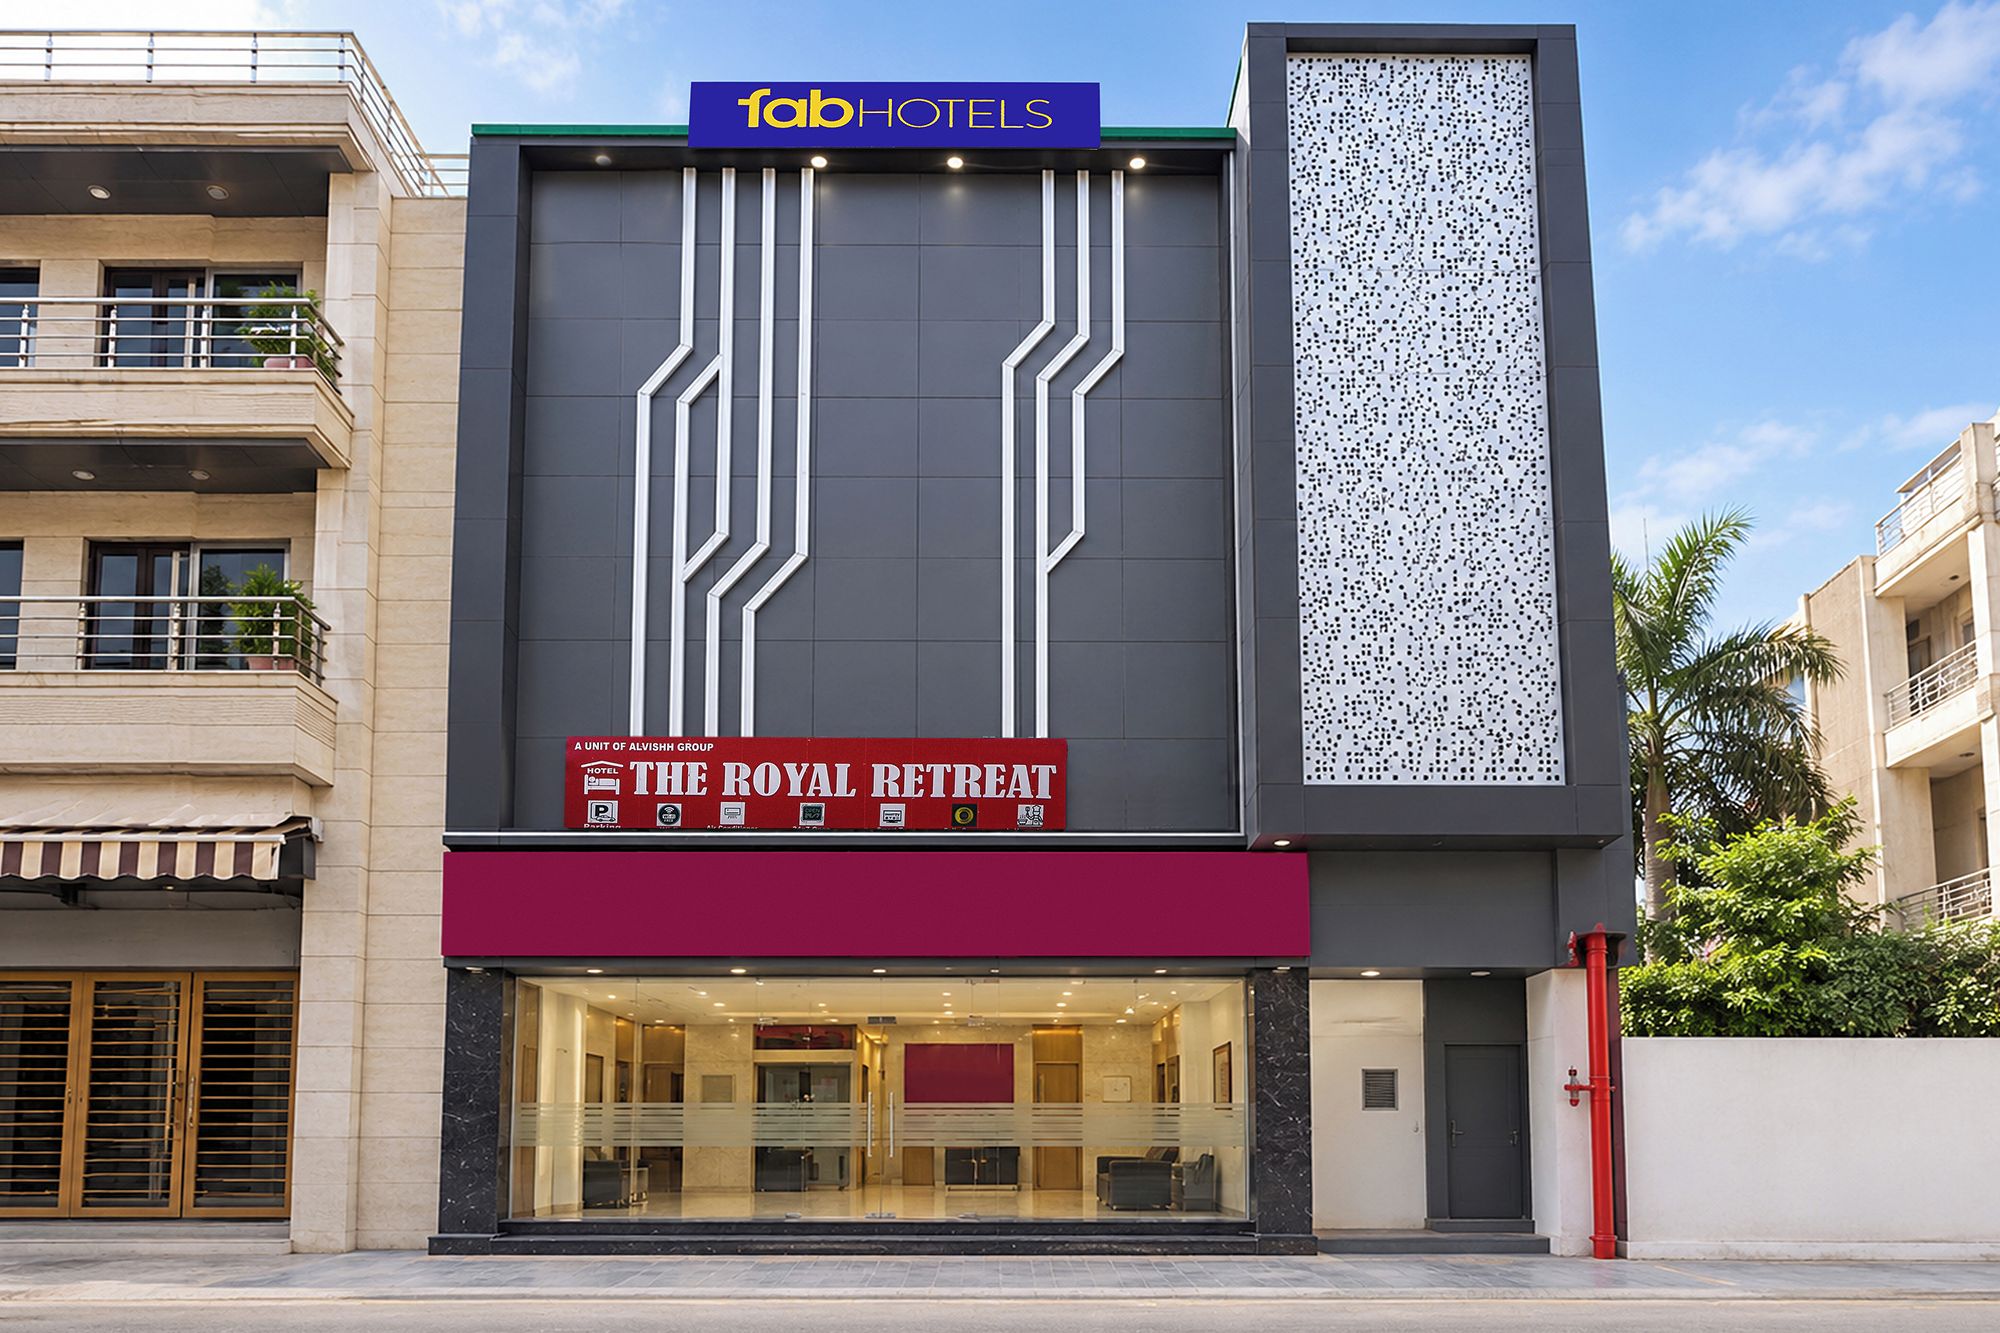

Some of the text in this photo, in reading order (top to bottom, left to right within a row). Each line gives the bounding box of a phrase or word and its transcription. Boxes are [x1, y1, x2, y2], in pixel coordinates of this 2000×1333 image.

[574, 742, 714, 752] A UNIT OF ALVISHH GROUP
[629, 761, 1057, 799] THE ROYAL RETREAT
[595, 804, 609, 817] P
